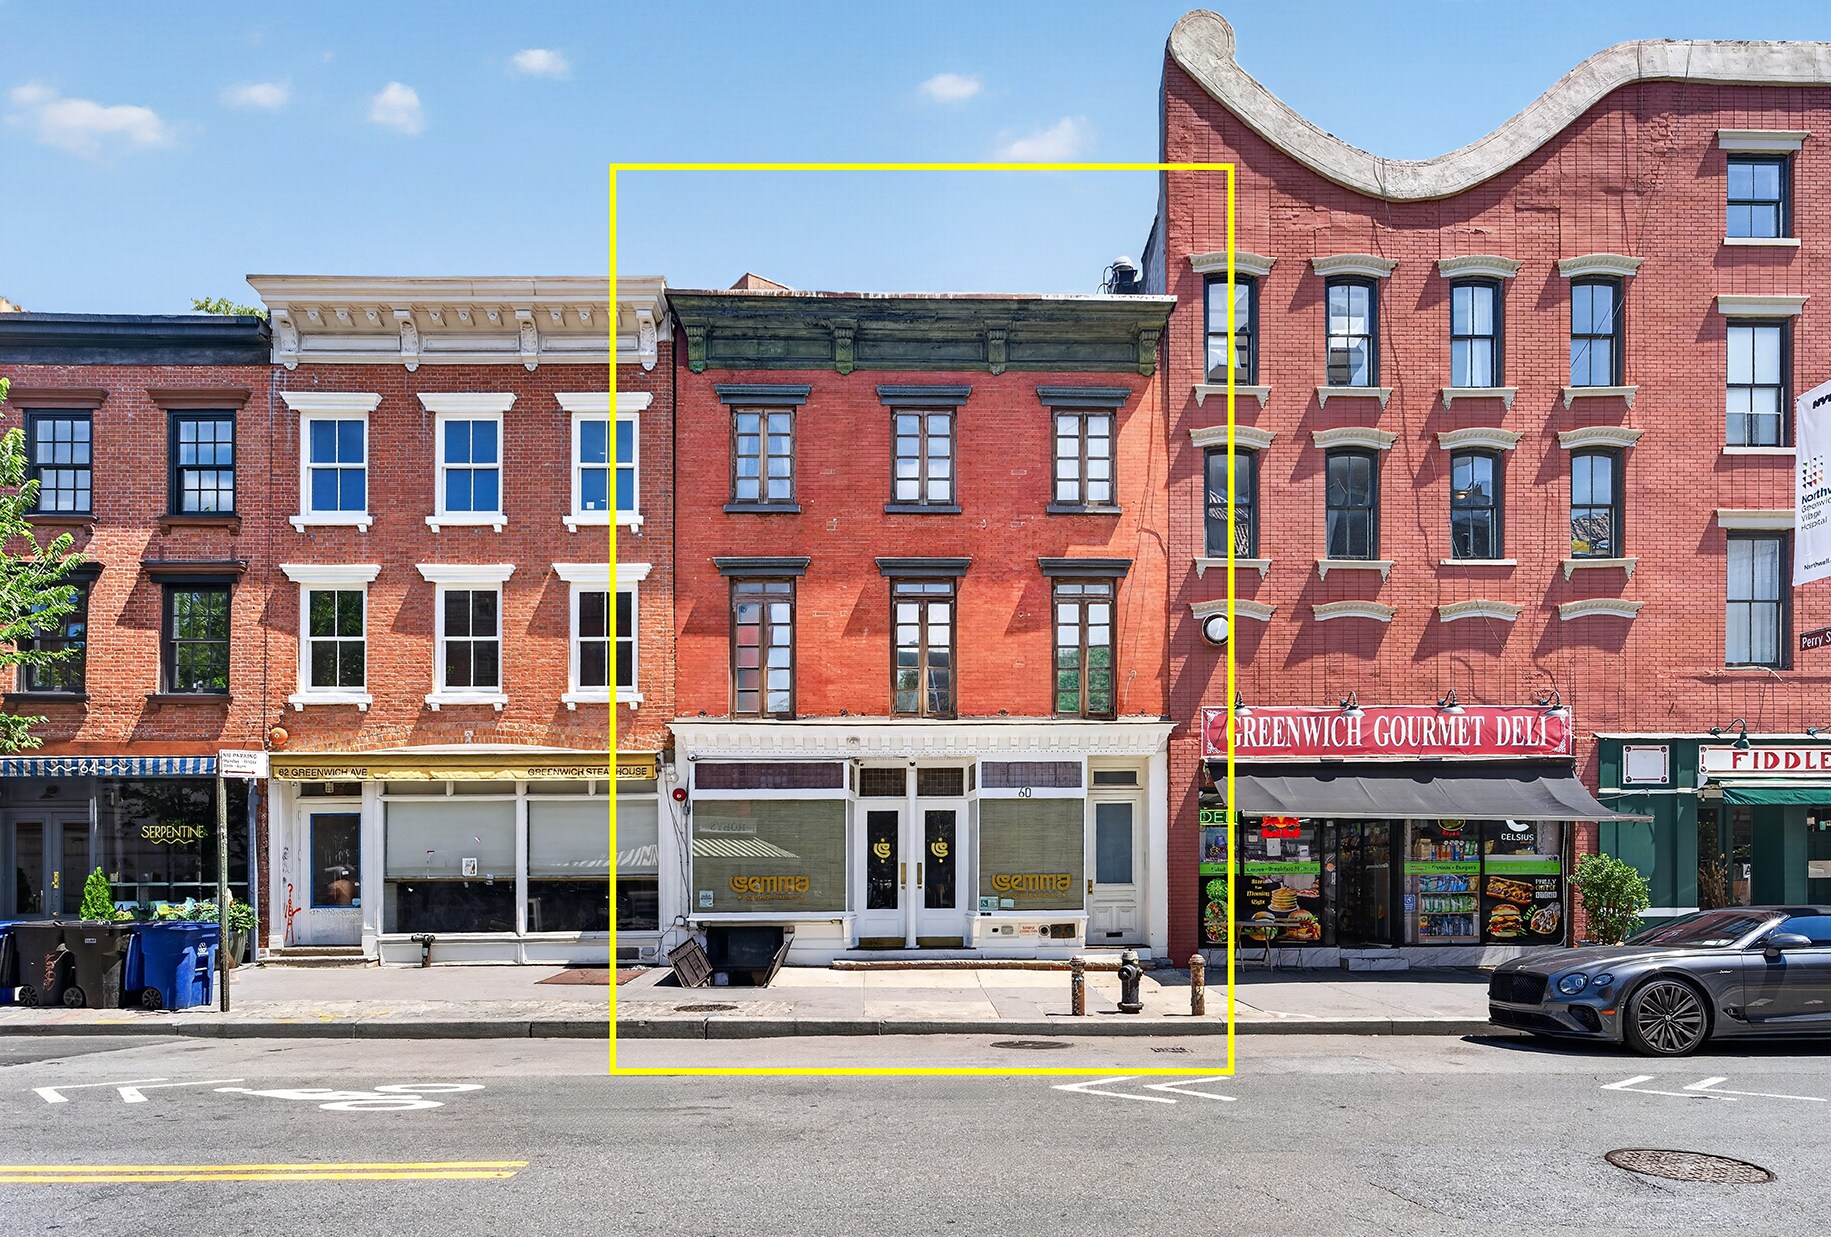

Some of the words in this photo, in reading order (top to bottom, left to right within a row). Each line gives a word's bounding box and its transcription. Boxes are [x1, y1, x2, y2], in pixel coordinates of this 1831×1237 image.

[1801, 635, 1823, 648] Perry
[1226, 715, 1361, 748] GREENWICH
[1373, 715, 1485, 747] GOURMET
[1495, 715, 1547, 747] DELI
[79, 760, 98, 774] 64
[291, 768, 348, 776] GREENWICH
[350, 768, 368, 776] AVE
[527, 768, 584, 776] GREENWICH
[586, 767, 647, 776] STEAHOUSE
[1018, 787, 1032, 798] 60
[140, 825, 204, 839] SERPENTINE
[1500, 833, 1534, 841] CELSIUS
